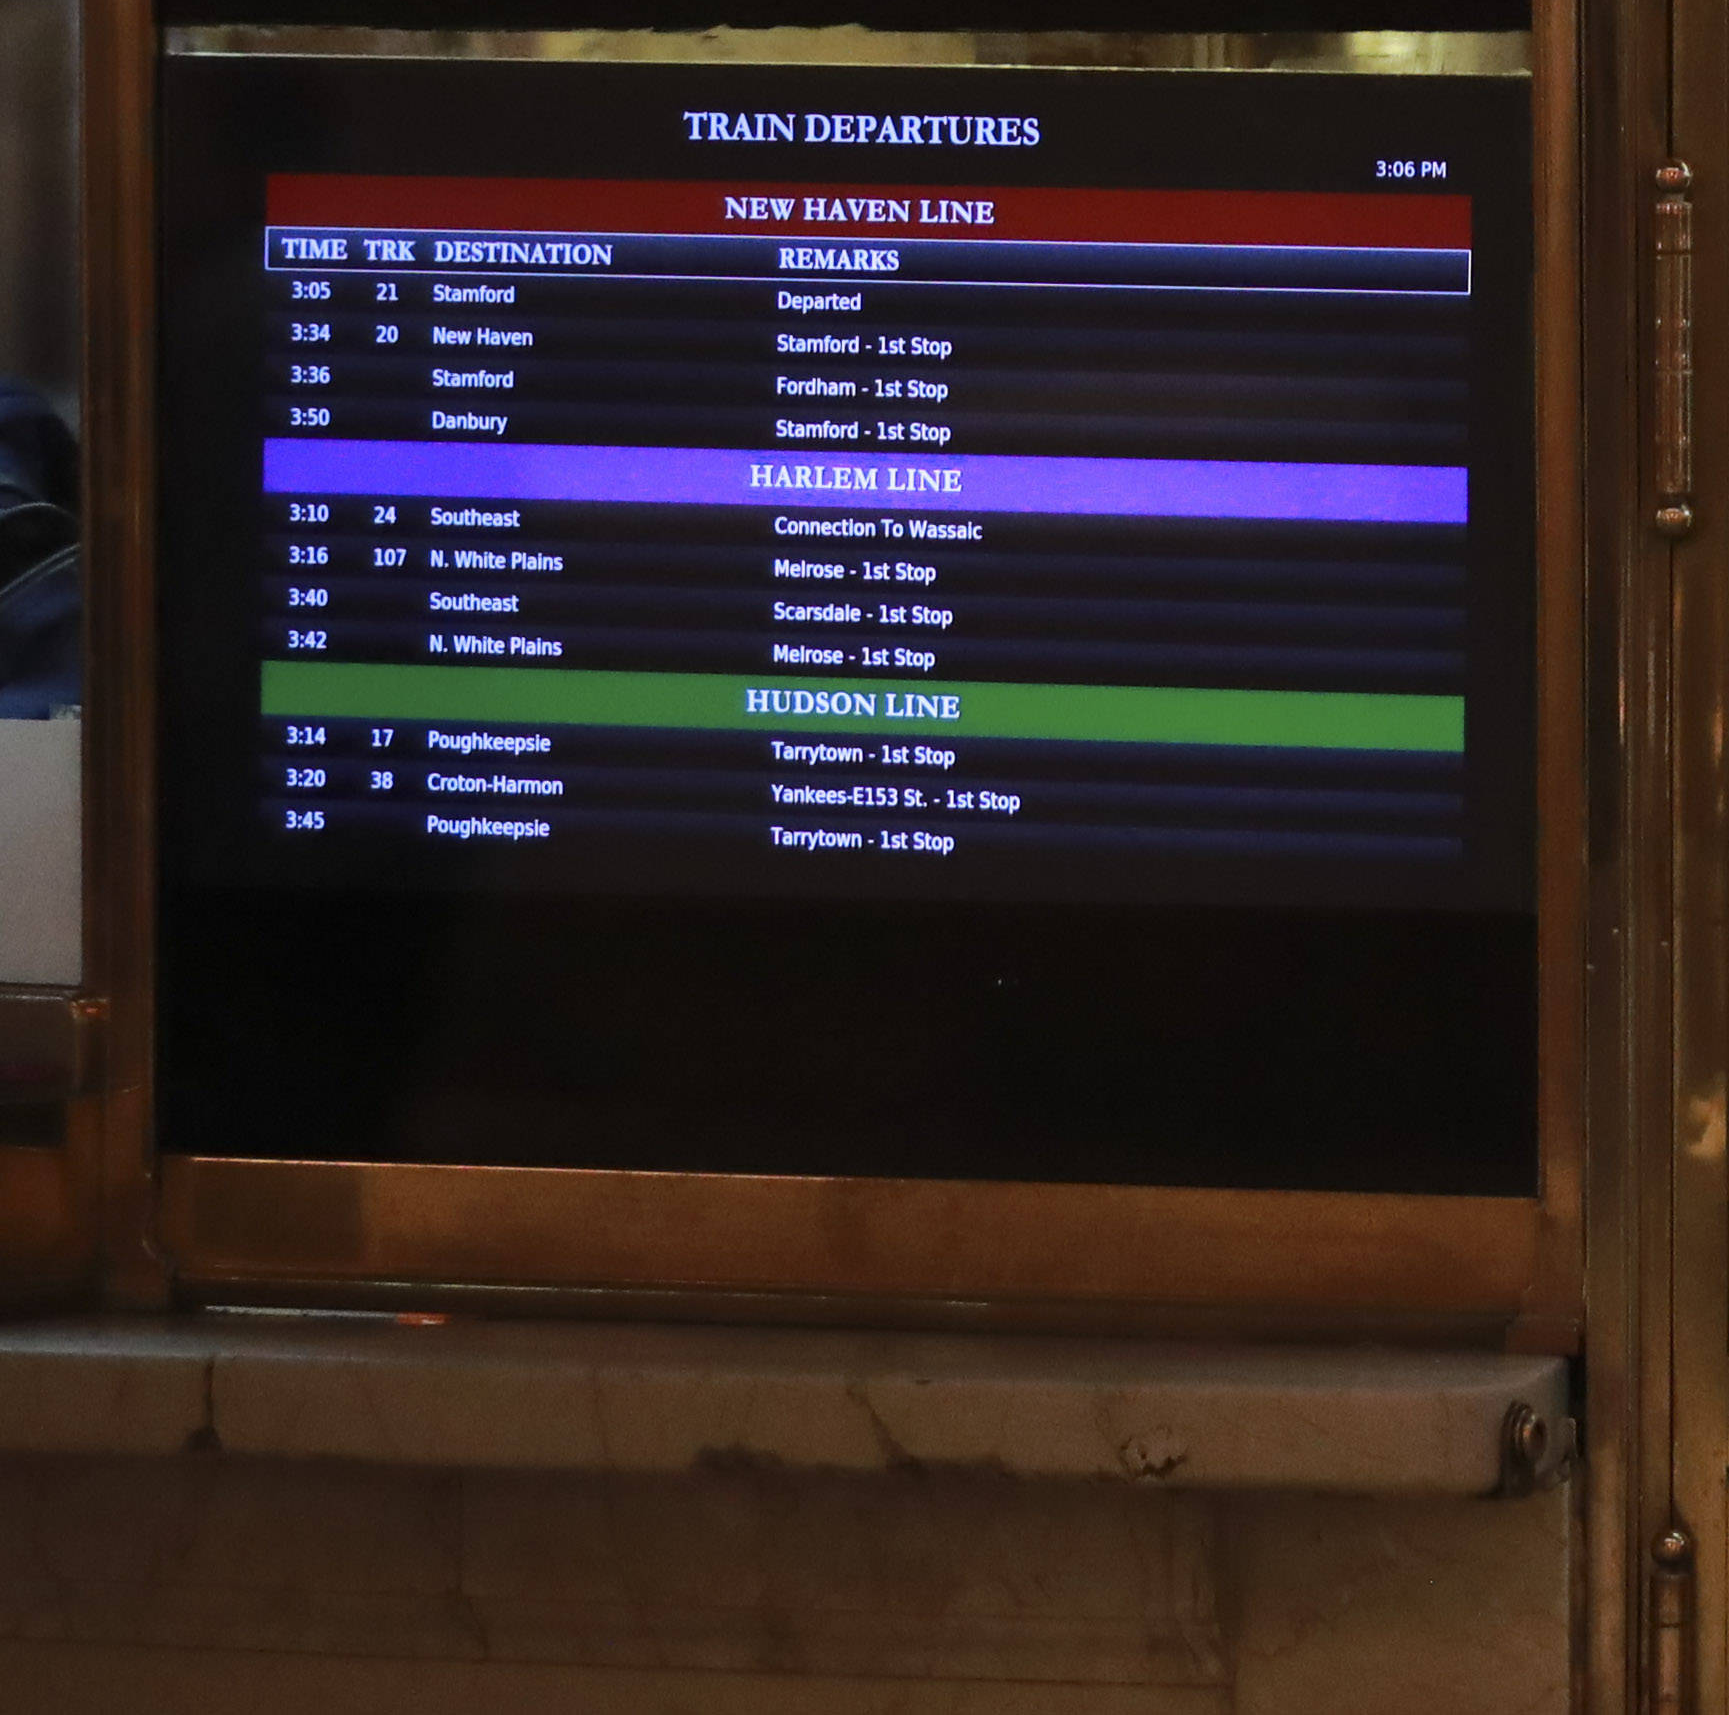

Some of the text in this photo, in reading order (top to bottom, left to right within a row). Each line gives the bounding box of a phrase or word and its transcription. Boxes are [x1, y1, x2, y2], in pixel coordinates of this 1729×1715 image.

[683, 111, 1040, 146] TRAIN DEPARTURES
[1376, 160, 1447, 179] 3:06 PM
[724, 196, 995, 225] NEW HAVEN LINE
[281, 237, 348, 260] TIME
[363, 238, 415, 262] TRK
[434, 240, 613, 266] DESTINATION
[779, 247, 900, 271] REMARKS
[292, 280, 331, 300] 3:05
[376, 282, 399, 302] 21
[433, 283, 515, 304] Stamford
[777, 290, 862, 315] Departed
[291, 322, 331, 342] 3:34
[376, 324, 399, 344] 20
[433, 326, 534, 346] New Haven
[777, 333, 860, 354] Stamford
[878, 335, 906, 355] 1st
[910, 336, 953, 360] Stop
[291, 365, 331, 384] 3:36
[432, 368, 514, 389] Stamford
[776, 376, 857, 397] Fordham
[874, 378, 903, 398] 1st
[907, 379, 949, 403] Stop
[290, 407, 330, 427] 3:50
[432, 410, 508, 436] Danbury
[775, 418, 859, 439] Stamford
[877, 421, 905, 441] 1st
[909, 422, 952, 446] Stop
[750, 464, 962, 493] HARLEM LINE
[289, 503, 329, 523] 3:10
[374, 505, 397, 524] 24
[430, 506, 521, 528] Southeast
[774, 516, 983, 540] Connection To Wassaic
[289, 545, 329, 565] 3:16
[374, 547, 407, 567] 107
[430, 549, 564, 571] N. White Plains
[774, 559, 845, 579] Melrose
[862, 562, 891, 581] 1st
[895, 562, 937, 586] Stop
[288, 587, 329, 607] 3:40
[429, 591, 519, 613] Southeast
[773, 601, 862, 623] Scarsdale
[879, 604, 907, 624] 1st
[911, 605, 954, 630] Stop
[288, 629, 327, 650] 3:42
[429, 634, 563, 657] N. White Plains
[773, 644, 844, 665] Melrose
[861, 646, 890, 666] 1st
[894, 648, 936, 672] Stop
[747, 689, 960, 719] HUDSON LINE
[287, 726, 326, 745] 3:14
[372, 728, 394, 748] 17
[428, 730, 552, 756] Poughkeepsie
[771, 740, 864, 766] Tarrytown
[881, 744, 910, 764] 1st
[914, 745, 956, 770] Stop
[286, 768, 326, 788] 3:20
[370, 770, 394, 790] 38
[427, 772, 564, 795] Croton-Harmon
[771, 784, 899, 807] Yankees-E153
[903, 788, 928, 808] St.
[946, 789, 975, 809] 1st
[978, 790, 1021, 815] Stop
[285, 810, 325, 830] 3:45
[427, 814, 551, 841] Poughkeepsie
[770, 826, 863, 851] Tarrytown
[880, 830, 909, 850] 1st
[912, 831, 955, 856] Stop
